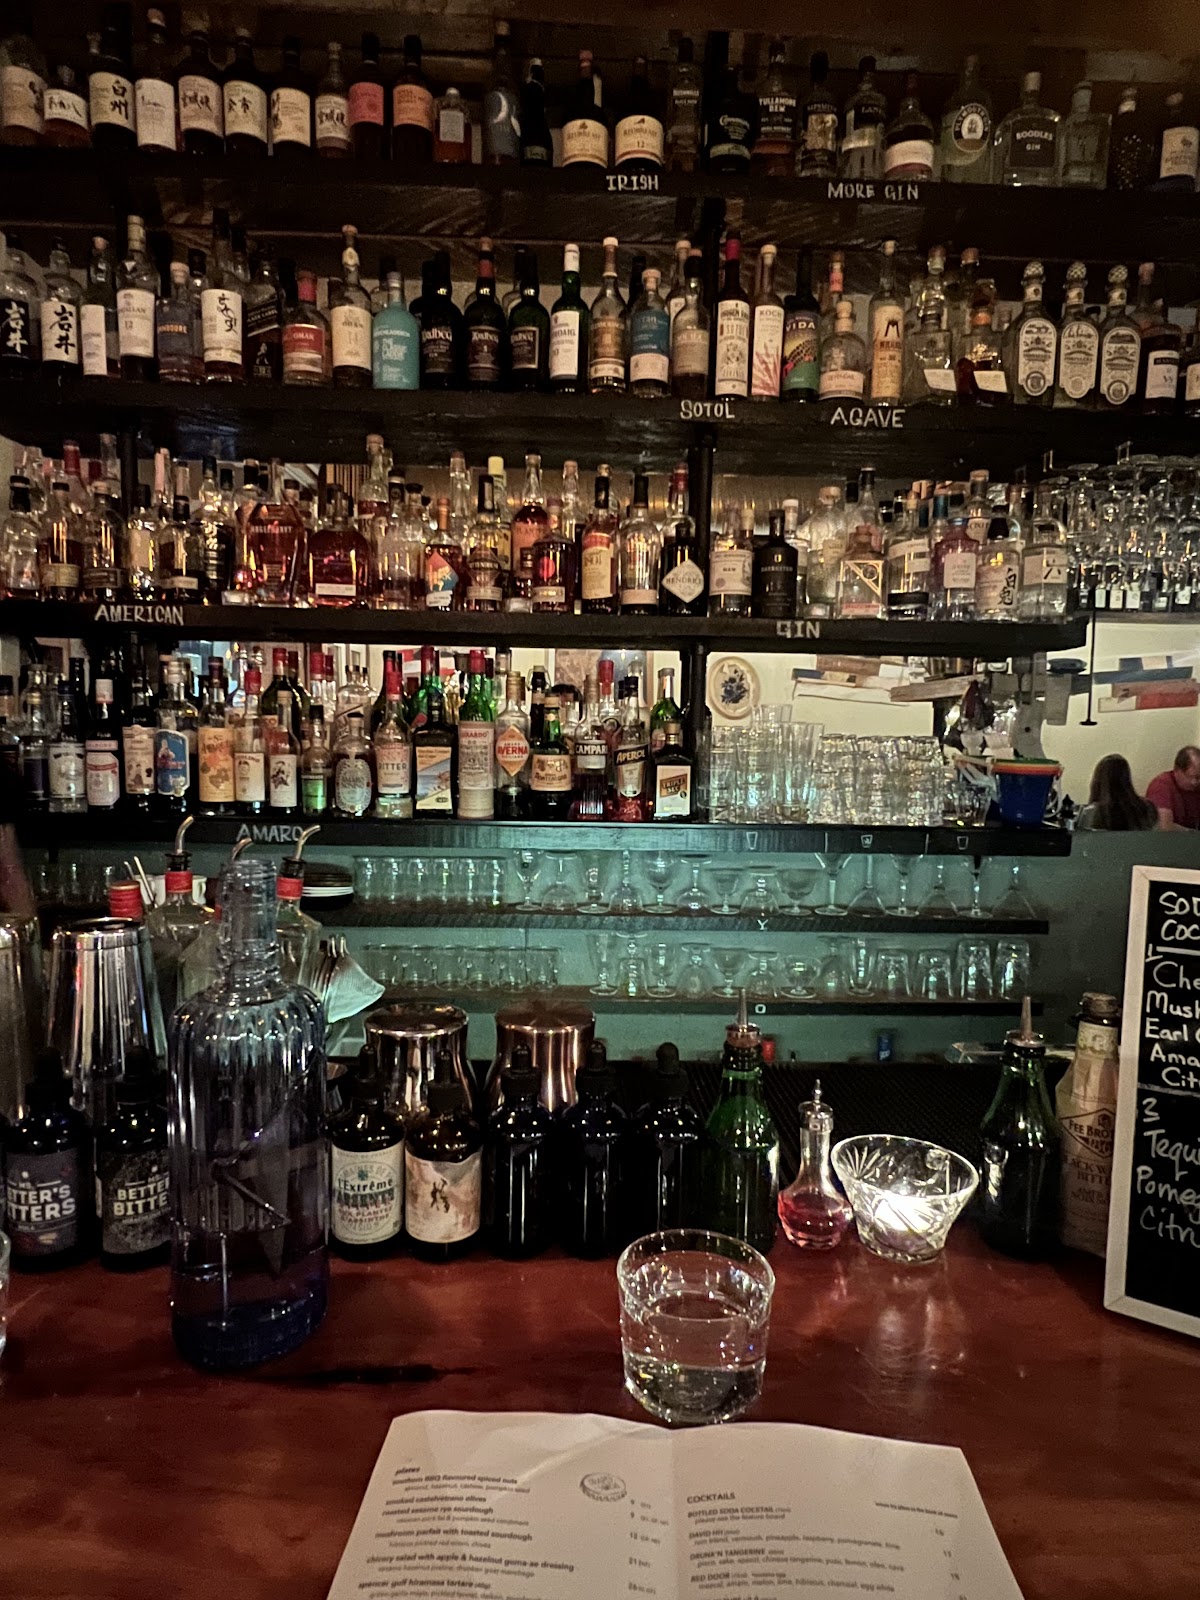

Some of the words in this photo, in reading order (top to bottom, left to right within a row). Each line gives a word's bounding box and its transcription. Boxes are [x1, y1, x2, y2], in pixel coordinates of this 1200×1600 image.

[1016, 130, 1053, 141] BOODLES
[606, 174, 659, 192] IRISH
[828, 182, 875, 199] MORE
[884, 184, 918, 200] GIN
[786, 322, 816, 332] VIDA
[680, 399, 735, 419] SOTOL
[830, 407, 906, 428] AGAVE
[94, 604, 184, 626] AMERICAN
[776, 620, 820, 638] GIN
[498, 746, 528, 755] AVERNA
[616, 750, 646, 764] APEROL
[236, 824, 304, 842] AMARO
[1145, 1017, 1189, 1042] Earl
[1069, 1119, 1084, 1134] FEE
[338, 1178, 393, 1192] L'Extrême
[386, 1497, 414, 1506] smoked
[687, 1492, 735, 1504] COCKTAILS
[454, 1506, 494, 1514] sourdough
[688, 1508, 718, 1518] BOTTLED
[375, 1530, 414, 1538] mushroom
[491, 1531, 532, 1542] sourdough
[689, 1530, 711, 1539] DAVID
[366, 1554, 394, 1564] chicory
[468, 1554, 502, 1564] hazelnut
[541, 1561, 574, 1572] dressing
[358, 1581, 389, 1590] spencer
[391, 1579, 407, 1588] gulf
[691, 1574, 706, 1583] RED
[708, 1572, 730, 1580] DOOR
